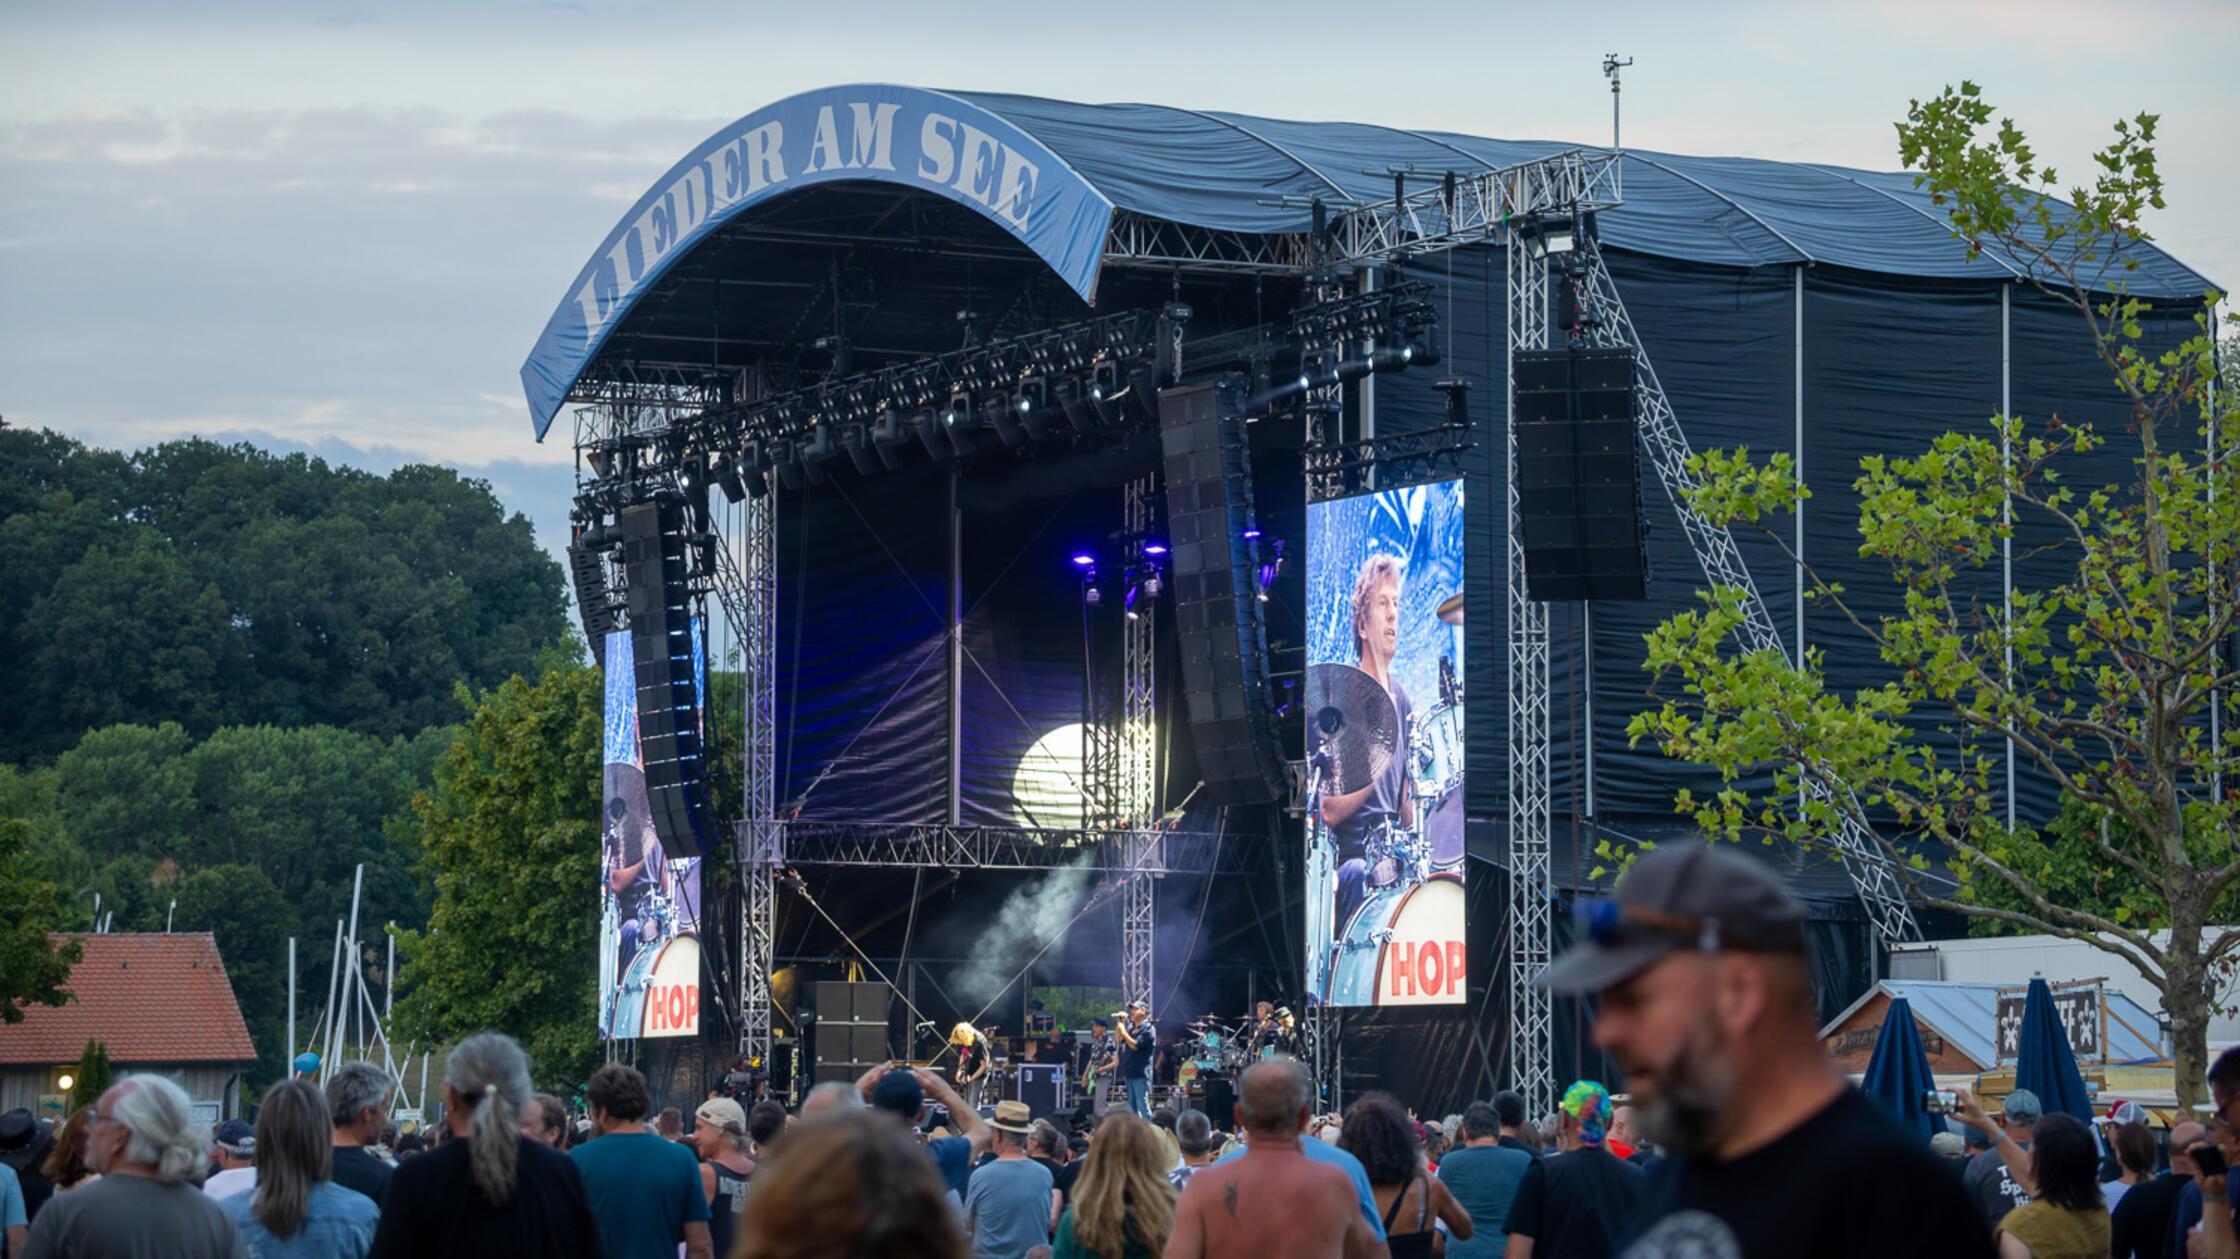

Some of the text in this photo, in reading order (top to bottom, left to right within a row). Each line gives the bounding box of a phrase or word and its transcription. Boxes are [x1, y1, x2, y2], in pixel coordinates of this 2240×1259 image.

[574, 102, 1040, 350] LIEDER AM SEE
[1391, 940, 1466, 997] HOP
[652, 984, 699, 1030] HOP
